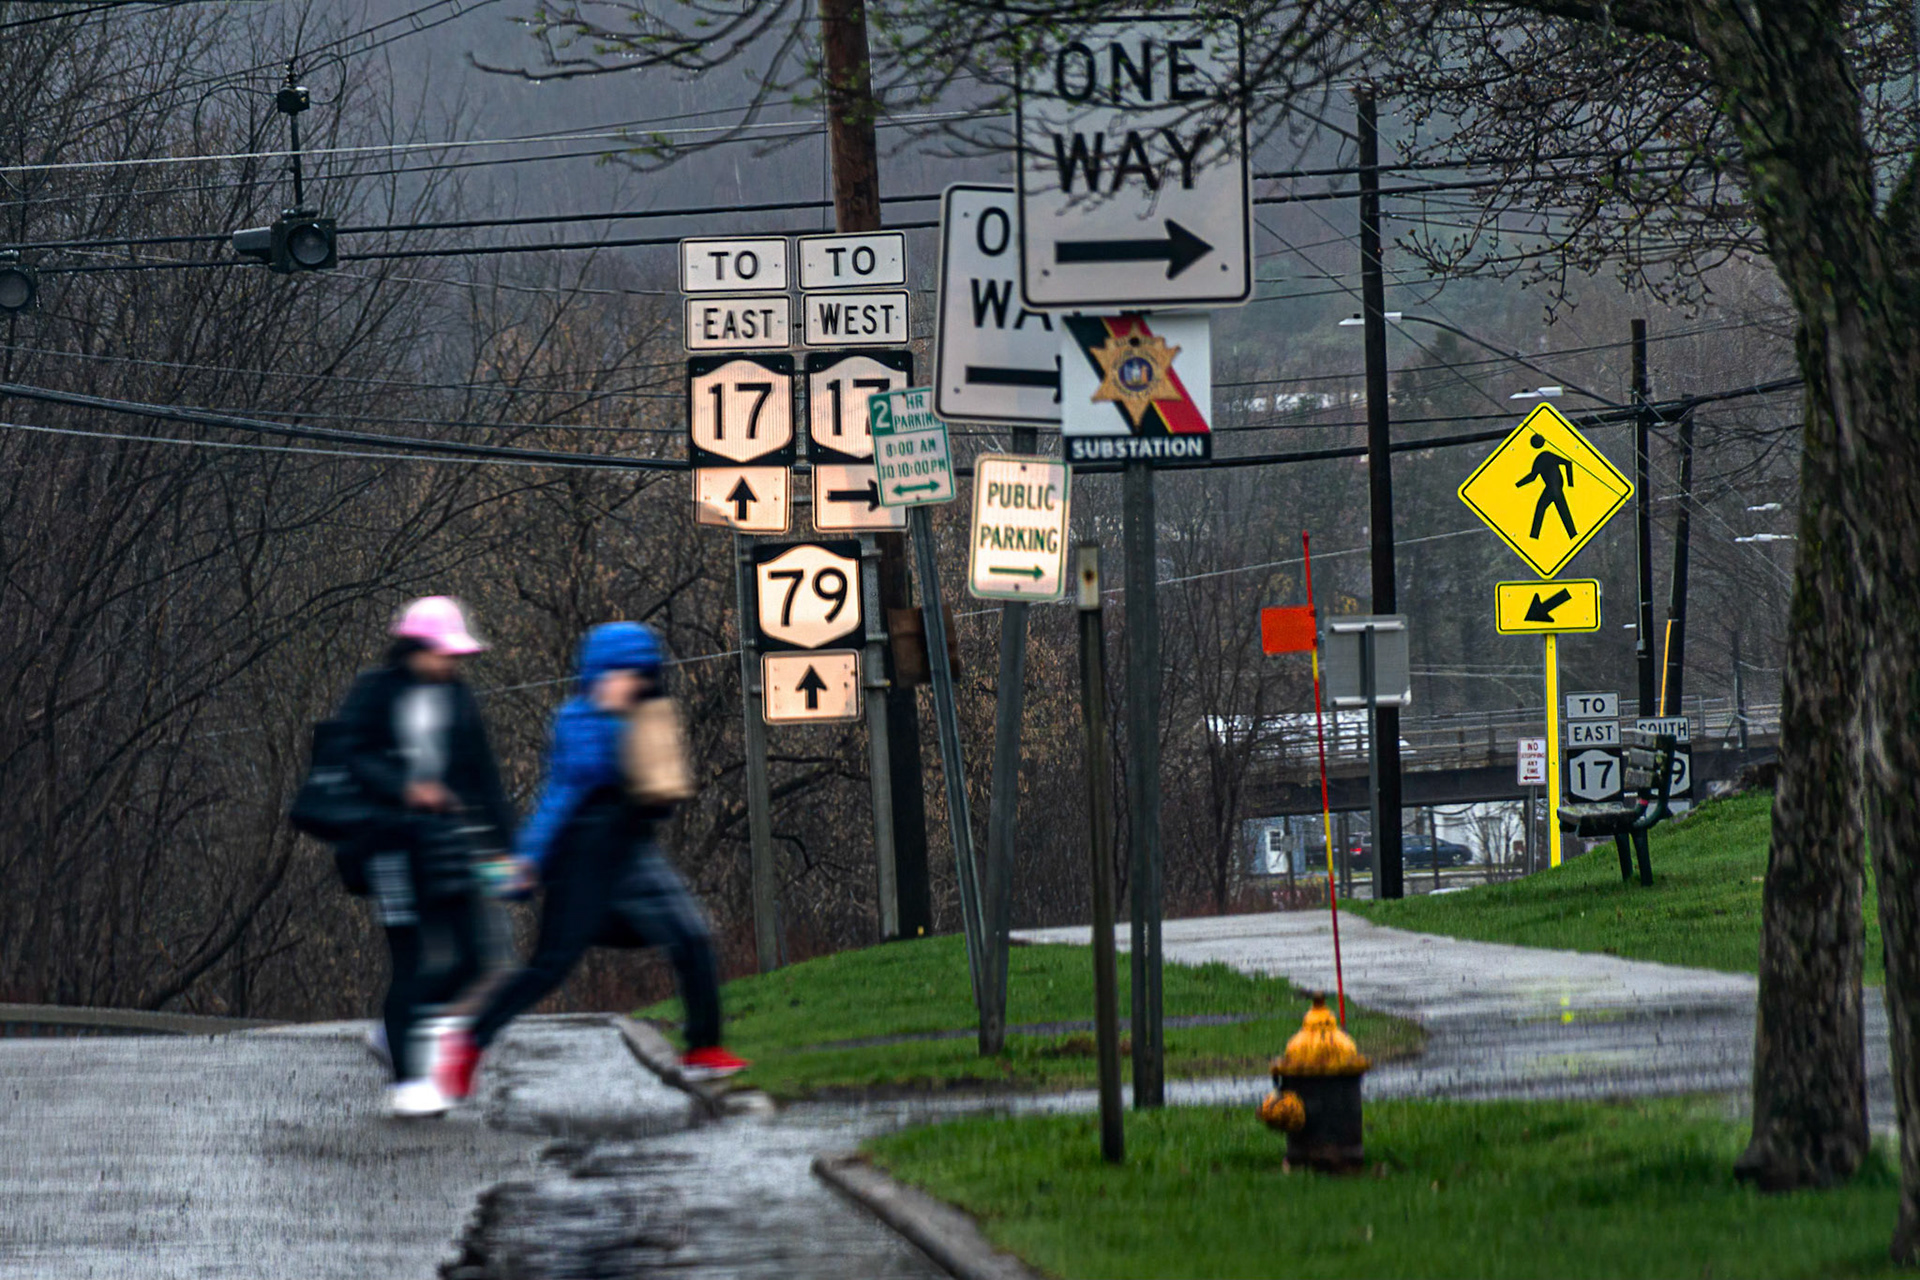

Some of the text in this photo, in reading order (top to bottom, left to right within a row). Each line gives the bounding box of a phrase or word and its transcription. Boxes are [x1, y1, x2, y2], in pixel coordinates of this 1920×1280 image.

[1056, 39, 1207, 101] ONE
[1054, 129, 1212, 193] WAY
[708, 250, 758, 281] TO
[825, 246, 876, 276] TO
[704, 307, 775, 340] EAST
[819, 304, 895, 335] WEST
[708, 382, 772, 440] 17
[827, 379, 890, 437] 17
[873, 394, 924, 429] 2 HR
[920, 438, 936, 453] AM
[1071, 436, 1203, 459] SUBSTATION
[988, 482, 1056, 511] PUBLIC
[980, 524, 1058, 554] PARKING
[768, 566, 848, 628] 79
[1579, 698, 1605, 714] TO
[1527, 742, 1539, 751] NO
[1574, 725, 1613, 742] EAST
[1577, 760, 1614, 790] 17
[1672, 757, 1686, 785] 9
